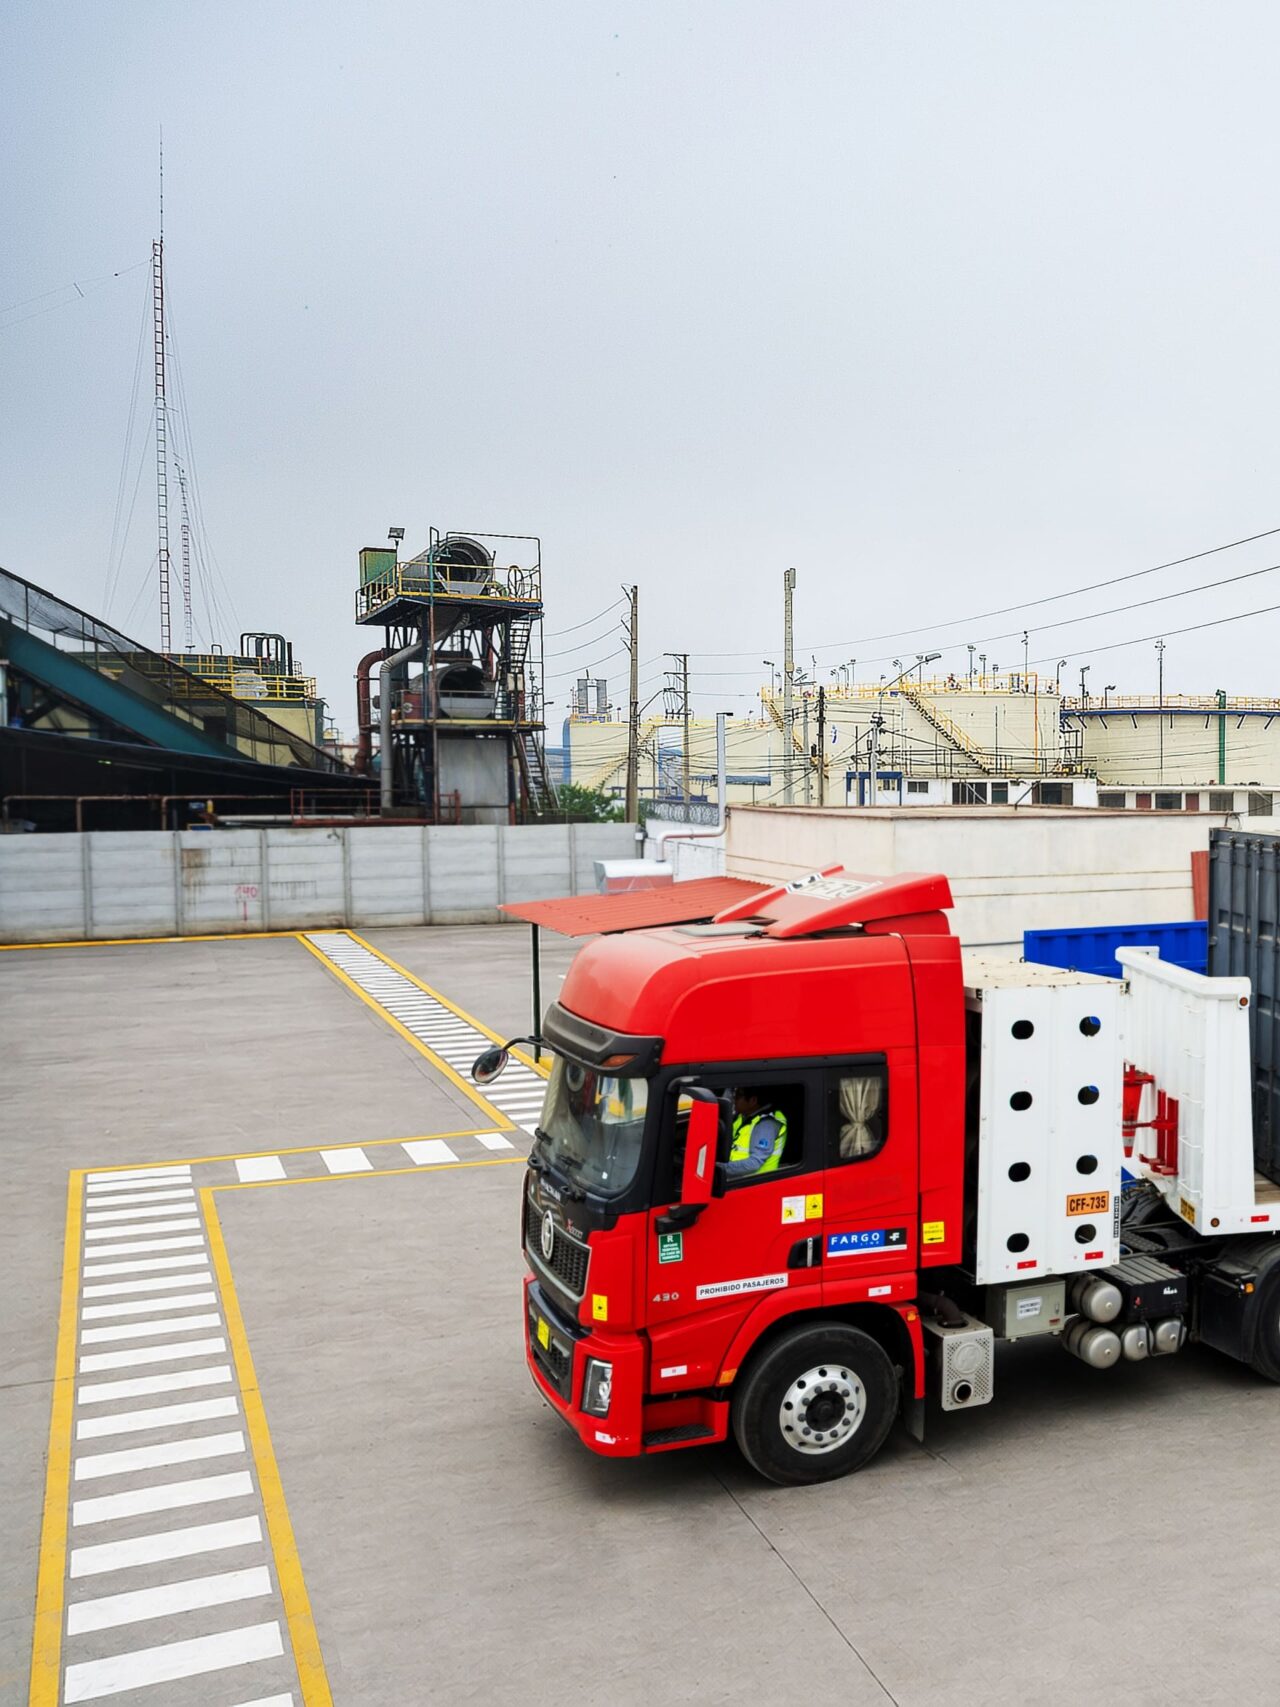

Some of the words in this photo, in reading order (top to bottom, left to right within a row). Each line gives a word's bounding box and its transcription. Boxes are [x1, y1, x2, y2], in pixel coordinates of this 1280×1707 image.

[1069, 1195, 1107, 1213] CFF-735
[666, 1234, 674, 1243] R
[831, 1232, 880, 1246] FARGO
[699, 1284, 741, 1296] PROHIBIDO
[742, 1277, 785, 1290] PASAJEROS
[652, 1291, 679, 1303] 430
